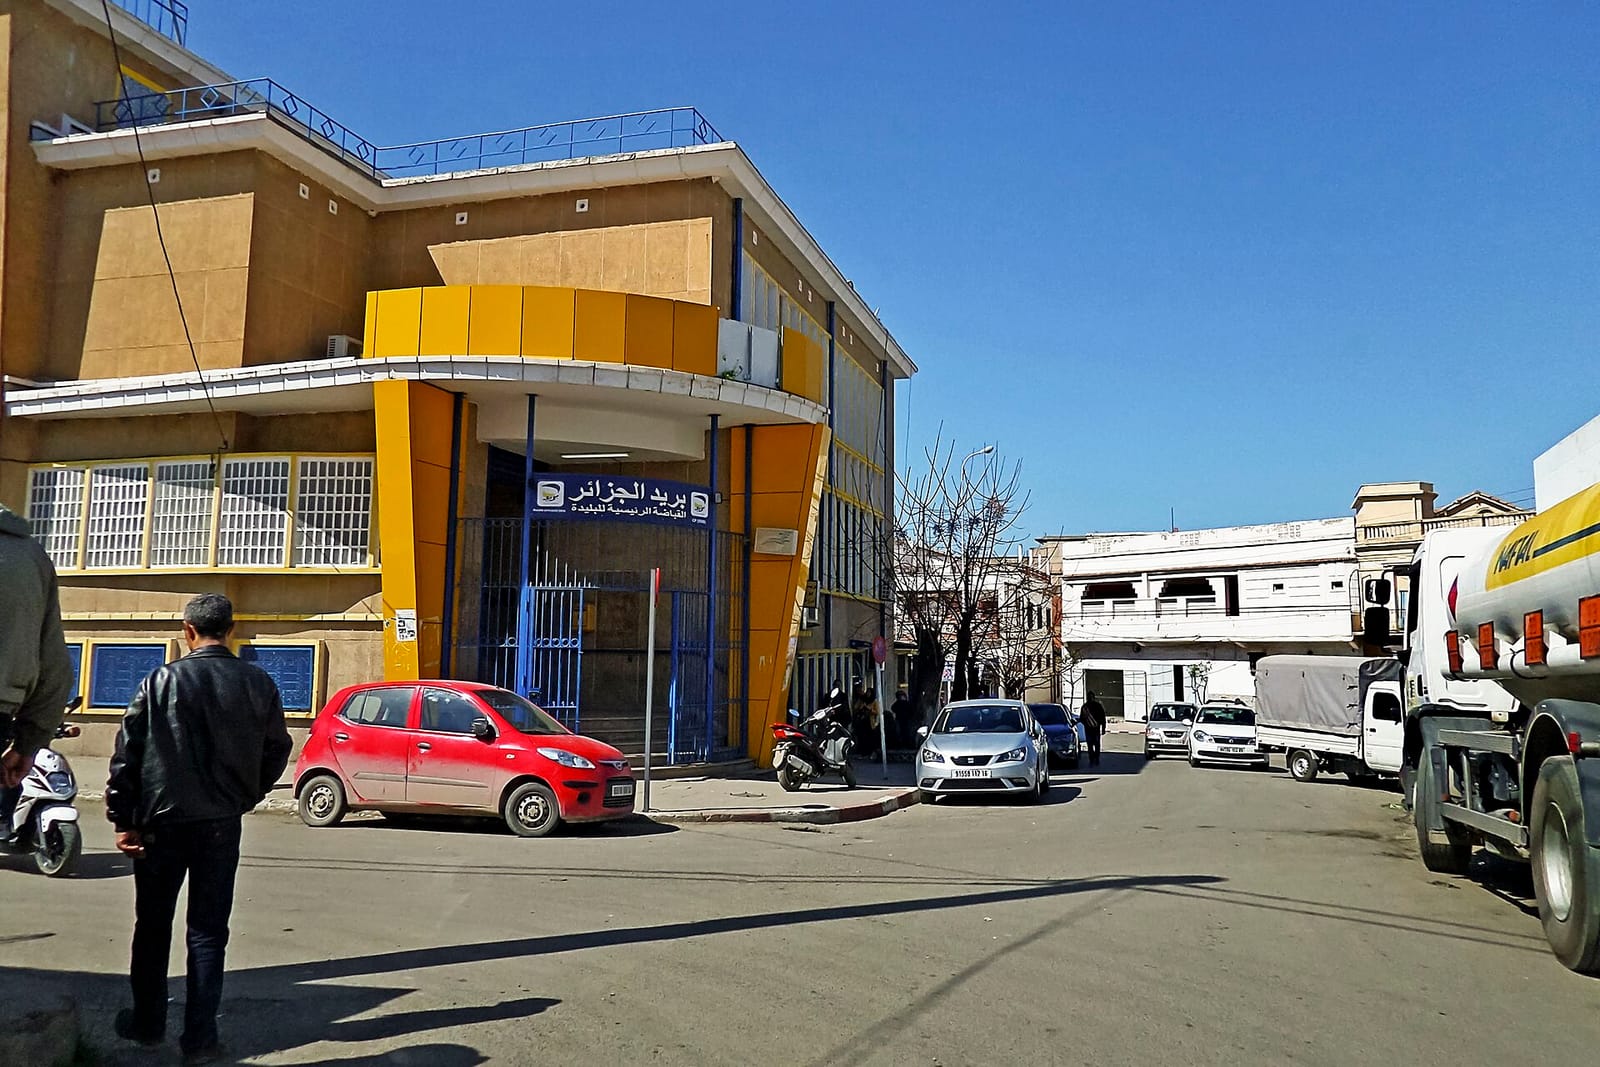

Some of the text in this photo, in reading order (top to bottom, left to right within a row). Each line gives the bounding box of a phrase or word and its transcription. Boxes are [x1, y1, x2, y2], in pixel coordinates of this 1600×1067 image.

[568, 480, 687, 509] بريد الجزائر
[571, 503, 687, 519] القباضة الرئيسية للبليدة
[1493, 529, 1540, 575] NAFTAL
